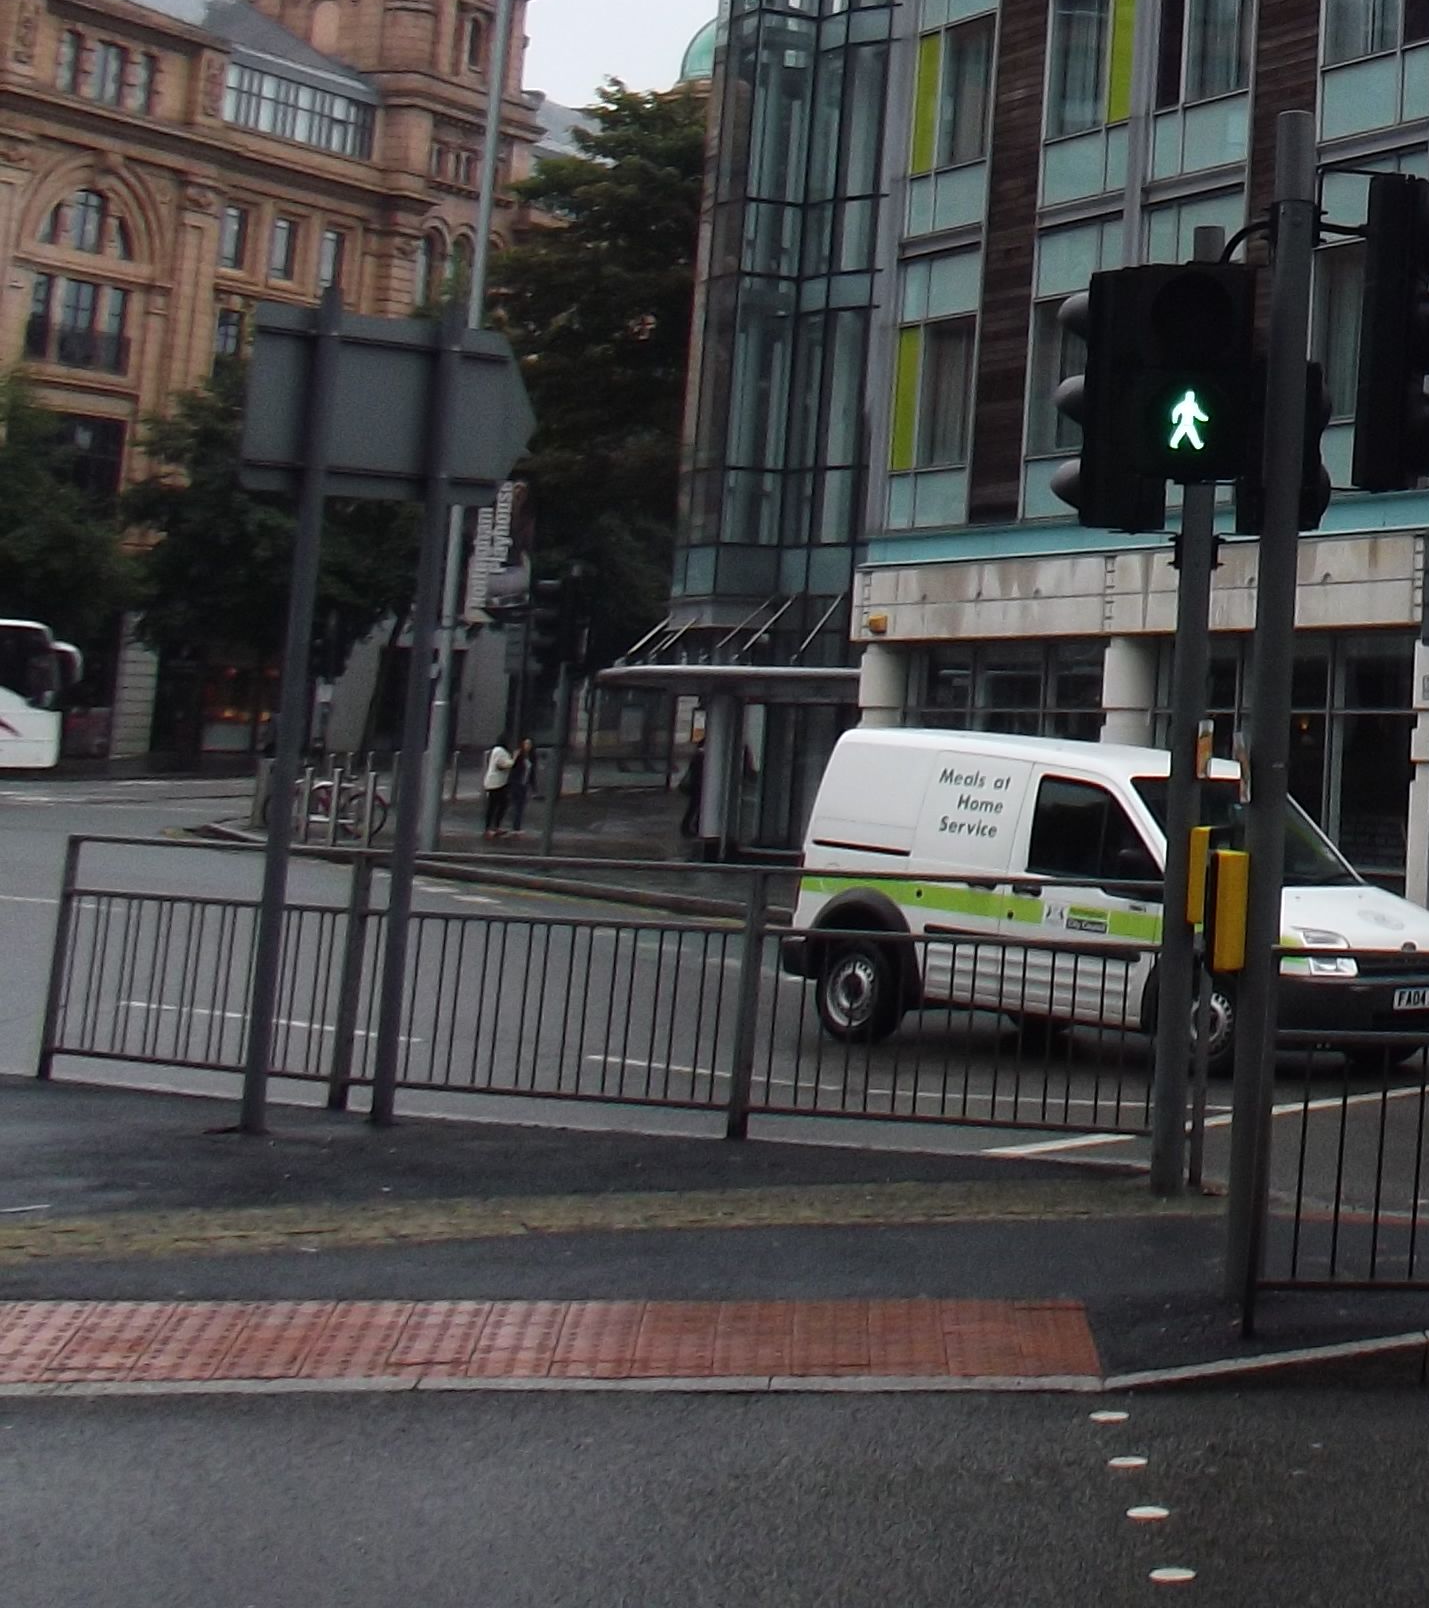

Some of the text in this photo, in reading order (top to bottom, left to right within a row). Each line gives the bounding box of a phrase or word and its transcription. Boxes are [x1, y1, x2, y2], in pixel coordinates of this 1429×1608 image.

[939, 767, 1011, 791] Meals at
[957, 793, 1004, 813] Home
[938, 814, 998, 838] Service
